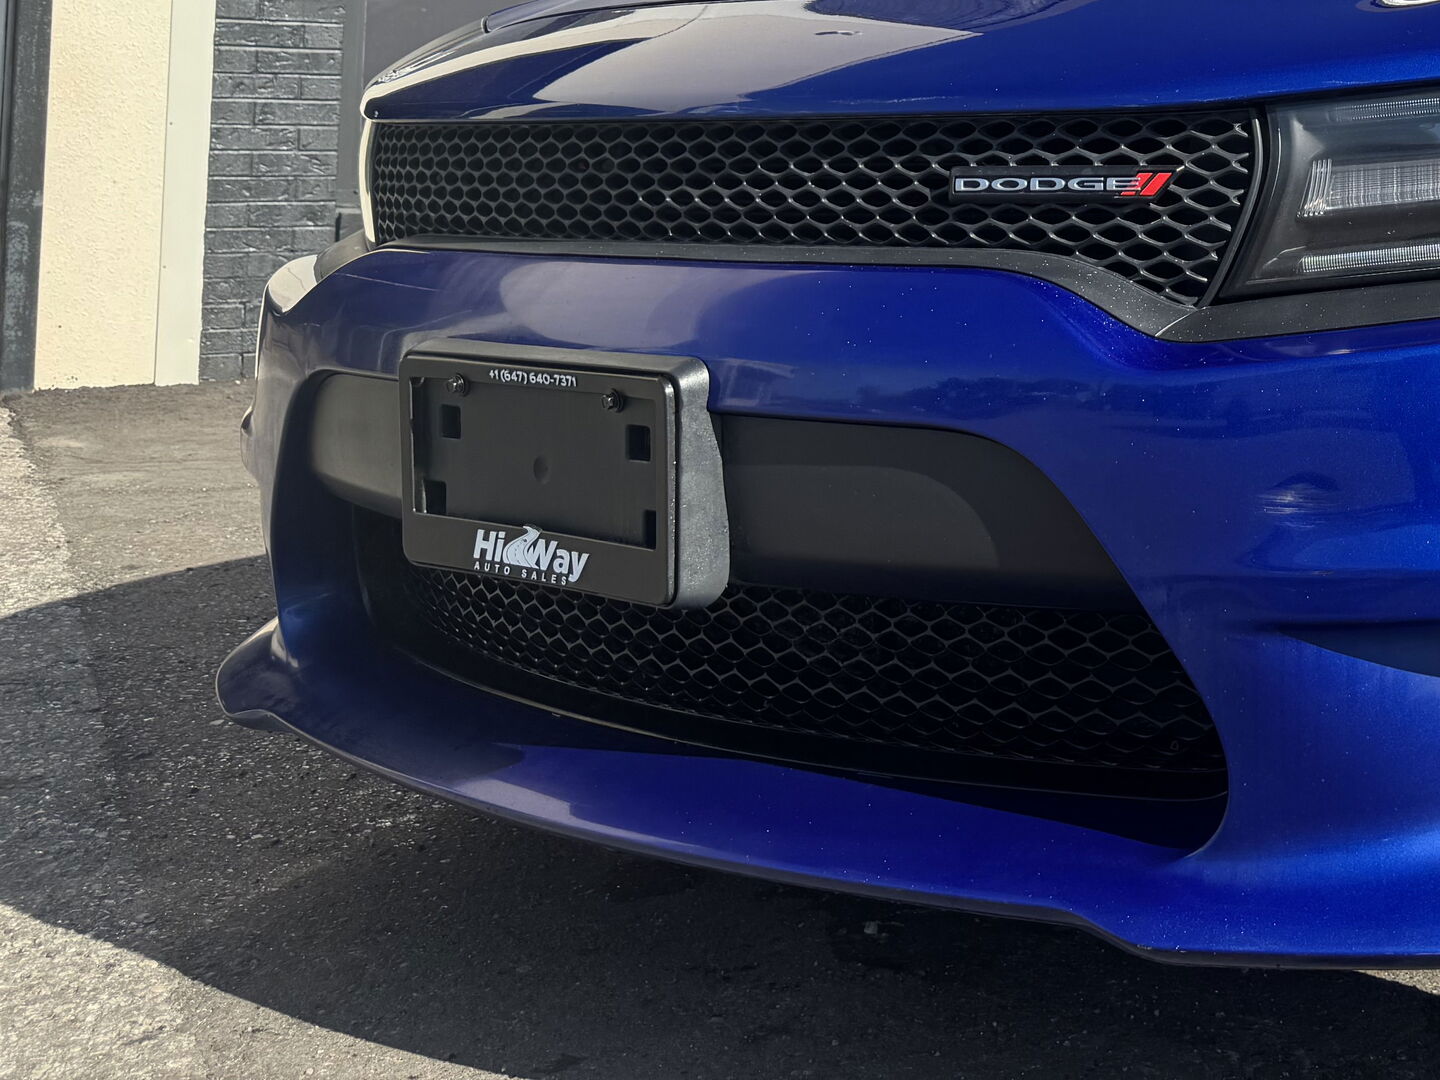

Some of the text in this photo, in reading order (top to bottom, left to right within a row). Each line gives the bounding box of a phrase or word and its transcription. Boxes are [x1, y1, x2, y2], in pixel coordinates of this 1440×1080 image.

[954, 177, 1141, 192] DODGE
[529, 372, 577, 387] 640-7371
[473, 561, 567, 586] AUTO SALES
